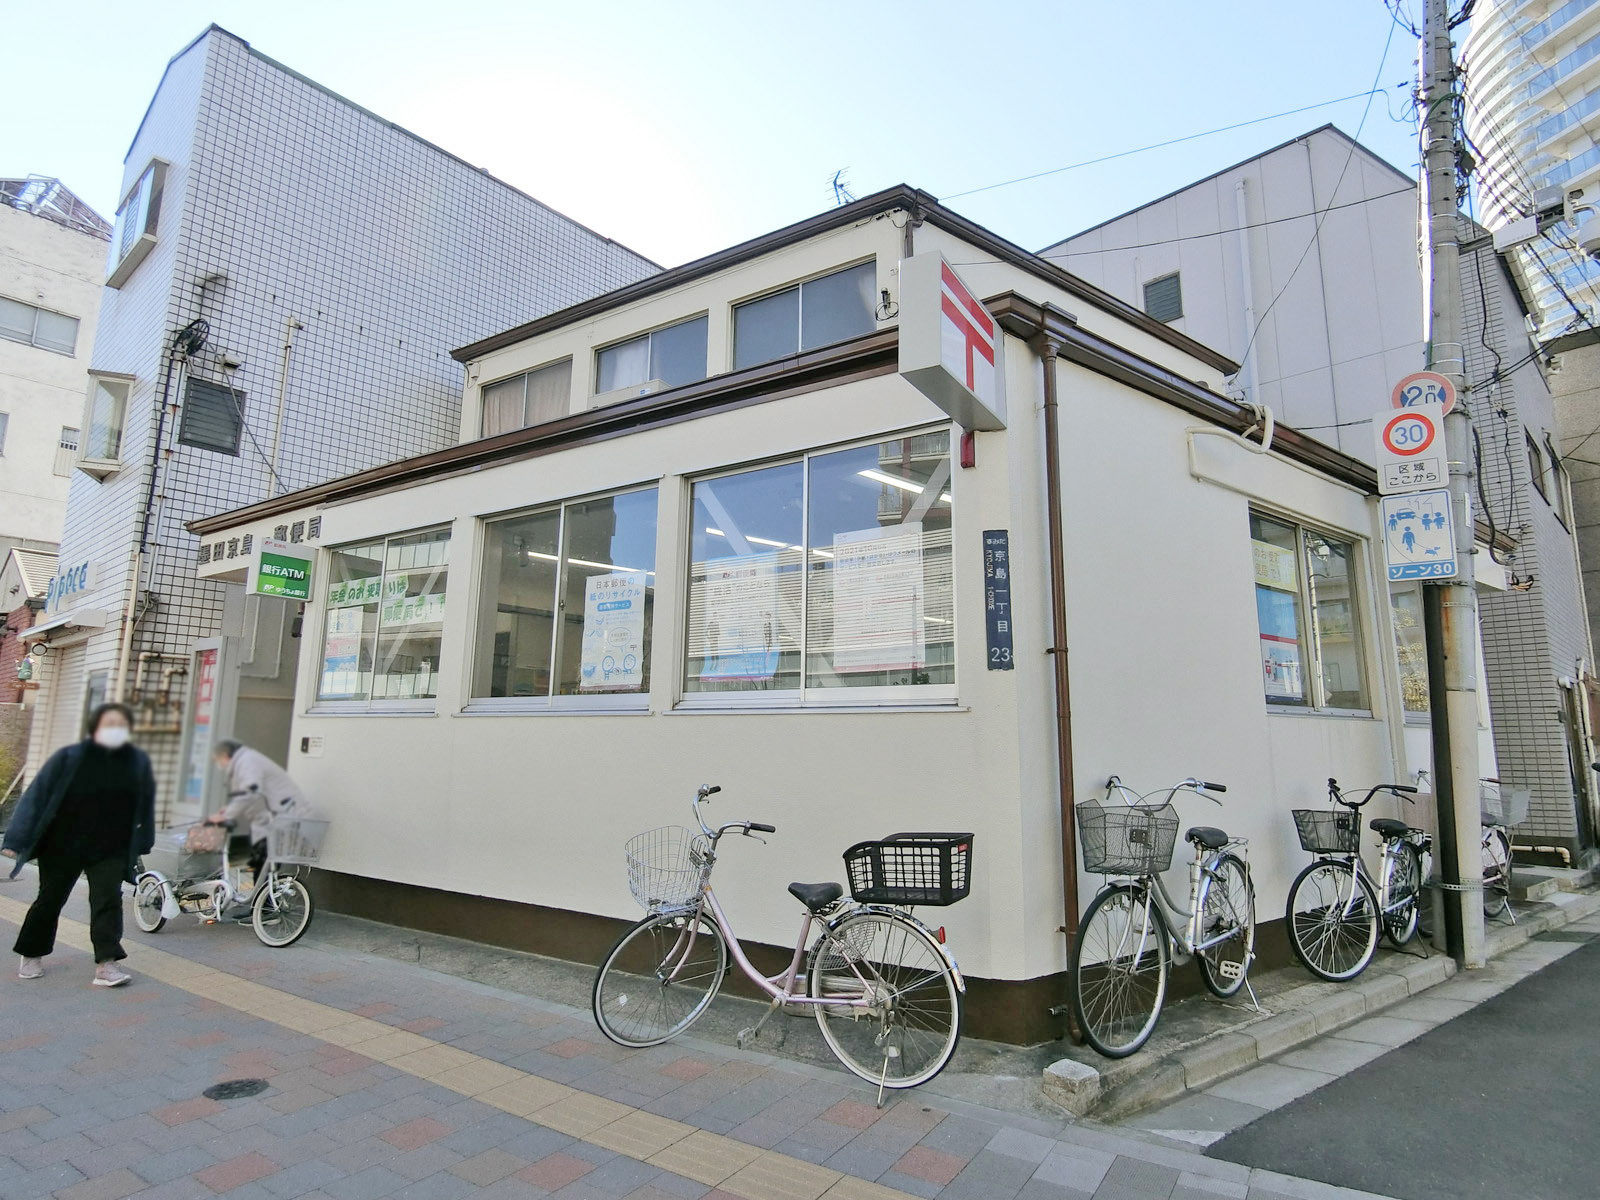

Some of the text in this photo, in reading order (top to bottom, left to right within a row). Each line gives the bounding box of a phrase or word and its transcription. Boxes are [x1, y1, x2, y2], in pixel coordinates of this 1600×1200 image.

[1394, 424, 1423, 445] 30
[1398, 462, 1425, 474] 区域
[1389, 472, 1437, 486] ここから
[261, 563, 305, 580] 銀行ATM
[596, 577, 635, 589] 日本郵便の
[994, 550, 1008, 632] 京島一丁目
[991, 647, 1010, 662] 23
